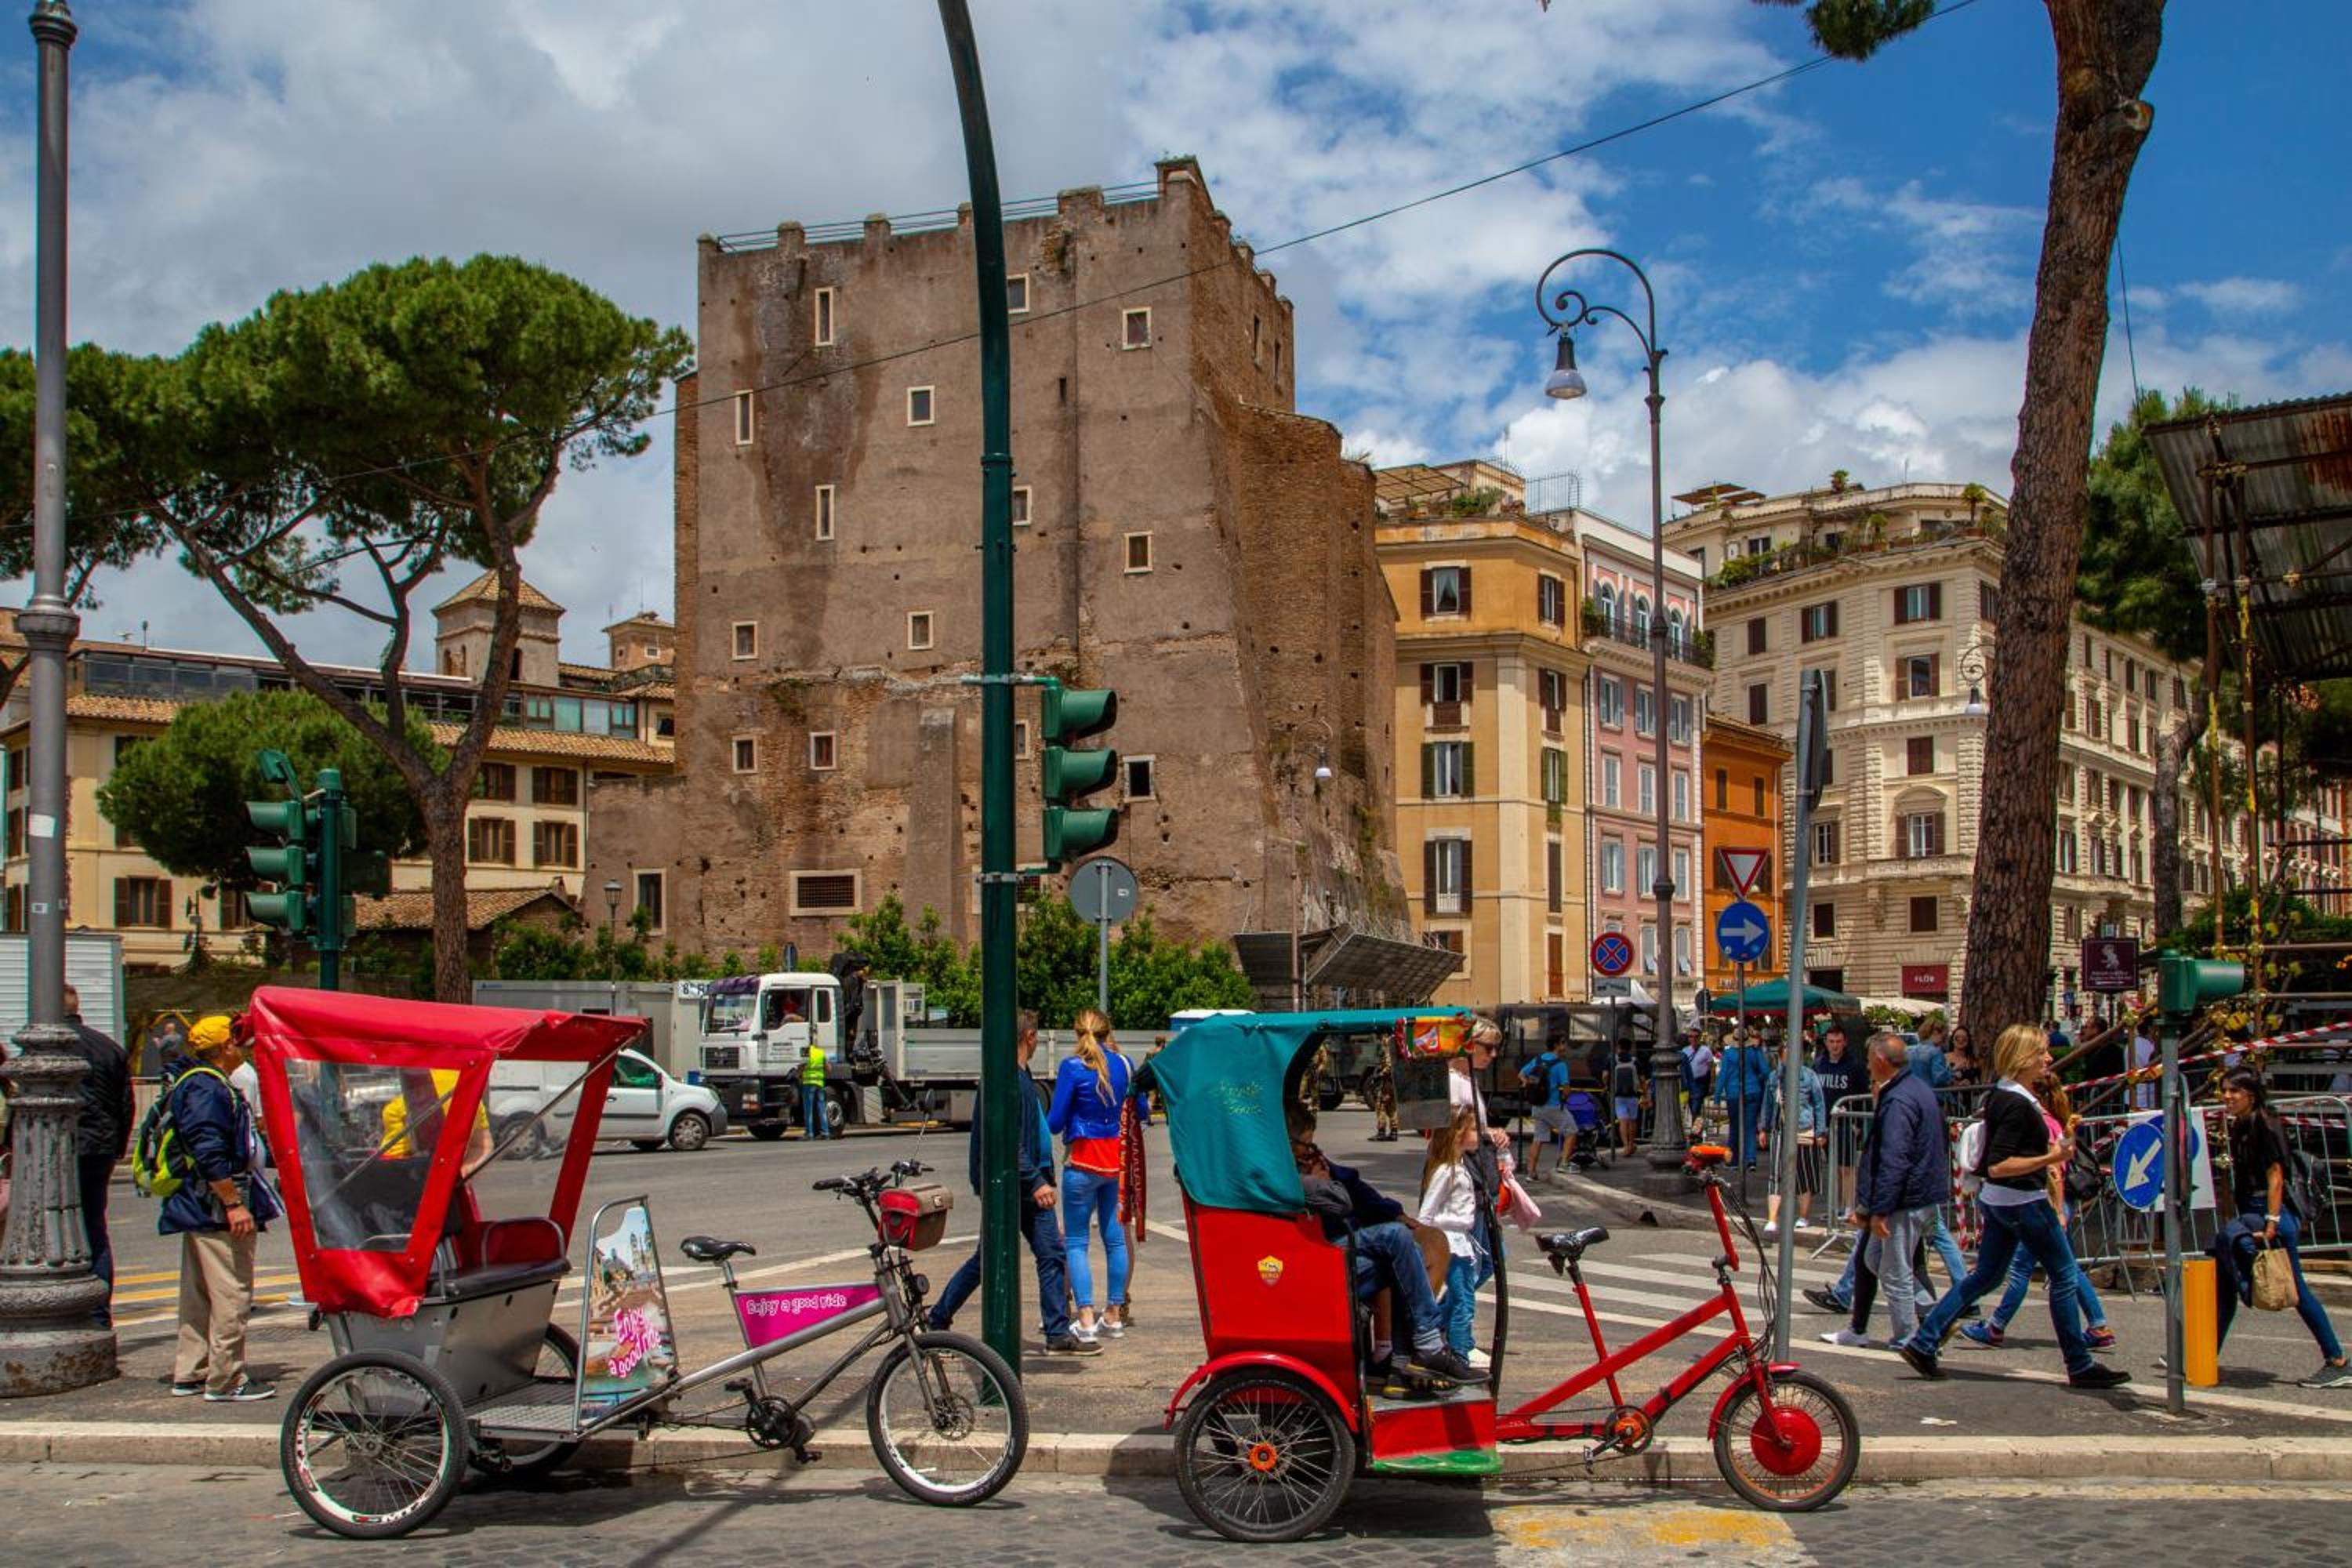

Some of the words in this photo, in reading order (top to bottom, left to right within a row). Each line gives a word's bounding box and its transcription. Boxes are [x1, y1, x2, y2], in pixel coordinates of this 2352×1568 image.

[746, 1298, 779, 1317] Enjoy
[780, 1301, 790, 1312] a
[792, 1296, 818, 1315] good
[615, 1308, 645, 1344] Enjoy
[608, 1359, 618, 1376] a
[619, 1334, 644, 1377] good
